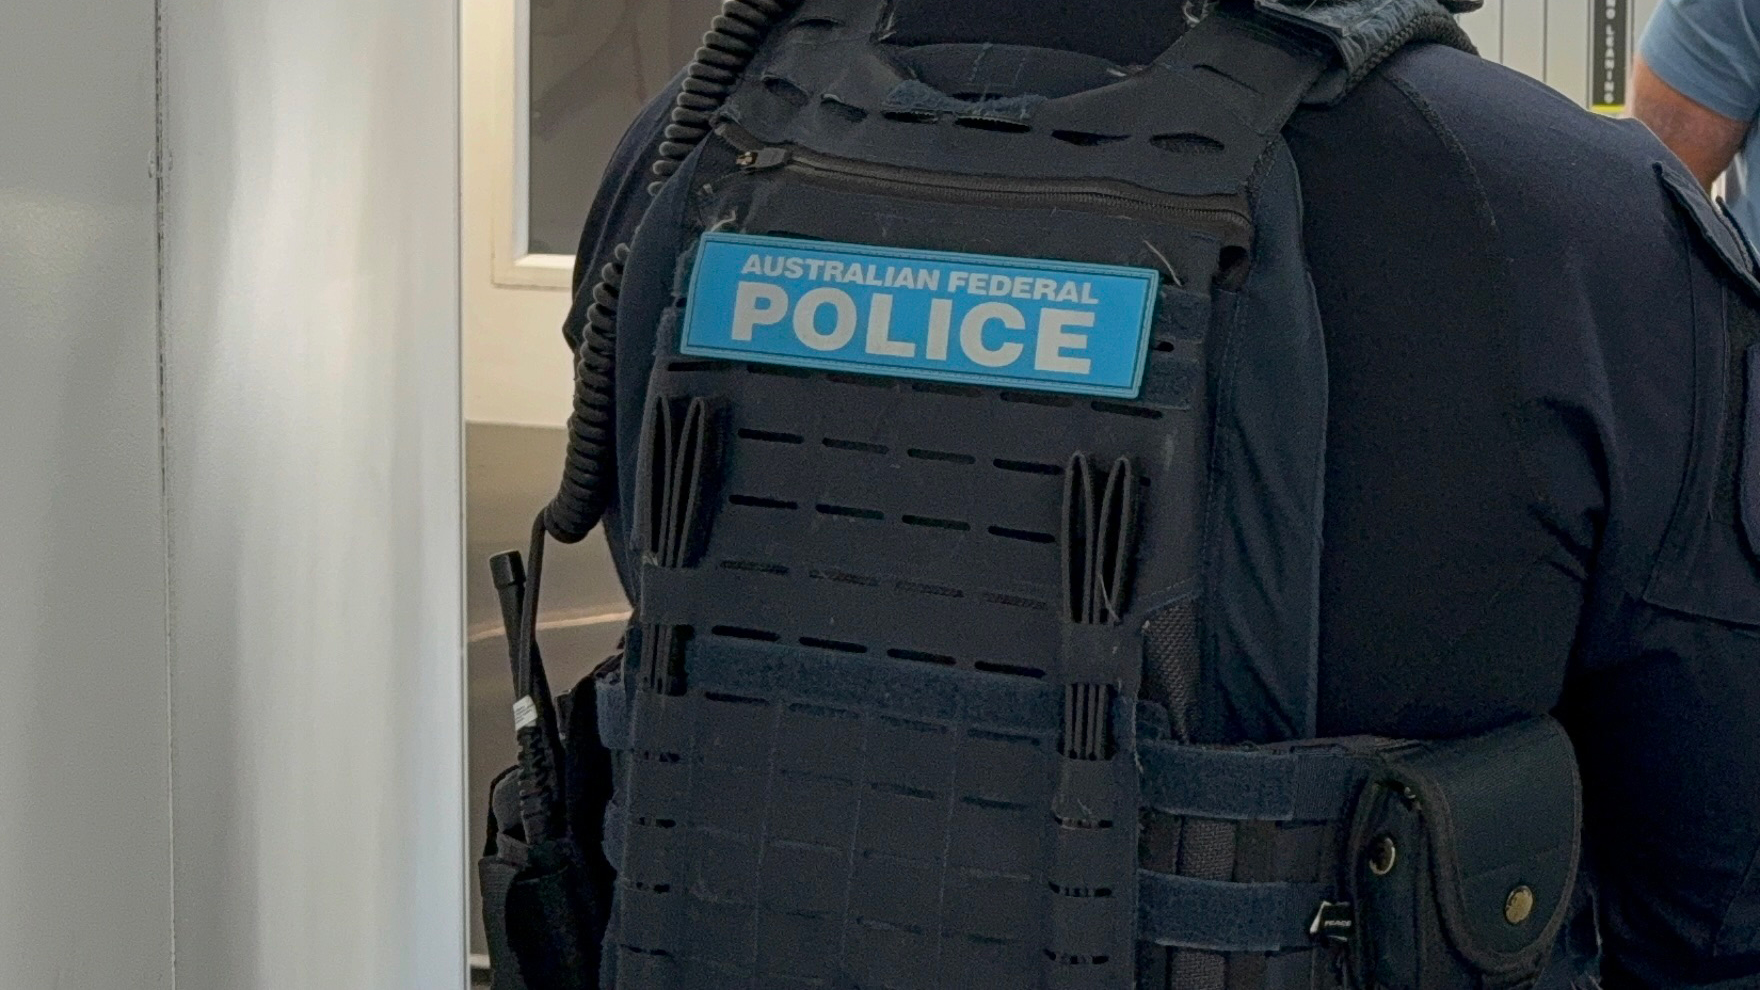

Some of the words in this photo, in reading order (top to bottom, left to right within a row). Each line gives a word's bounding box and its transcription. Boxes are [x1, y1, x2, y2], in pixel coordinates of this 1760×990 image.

[1603, 23, 1616, 105] LEANING
[741, 254, 940, 291] AUSTRALIAN
[949, 270, 1099, 304] FEDERAL
[731, 281, 1096, 375] POLICE
